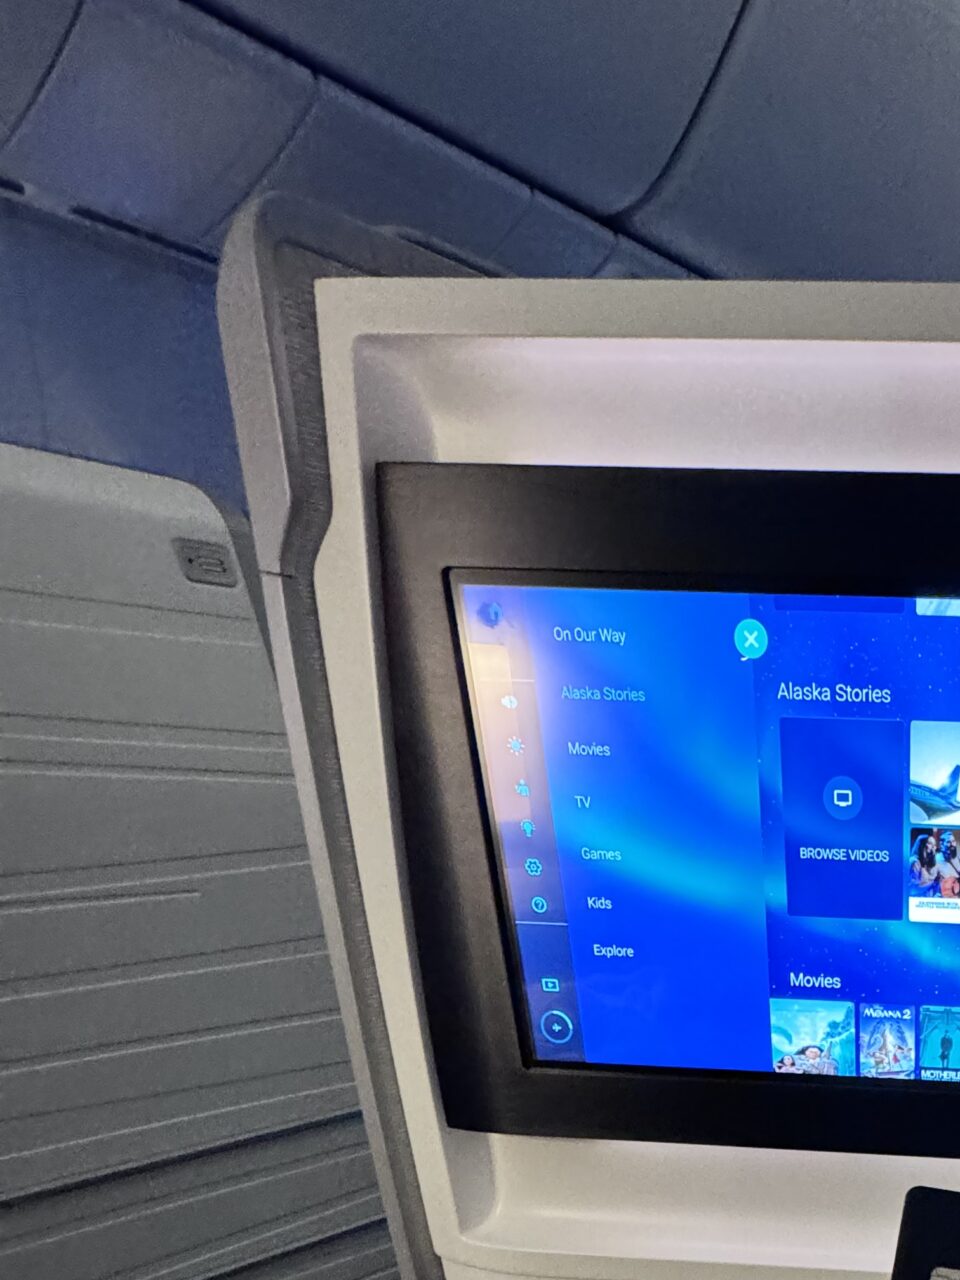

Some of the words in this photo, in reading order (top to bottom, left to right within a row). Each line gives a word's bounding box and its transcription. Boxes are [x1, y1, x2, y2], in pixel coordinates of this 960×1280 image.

[553, 626, 572, 642] On
[574, 627, 597, 643] Our
[599, 628, 626, 646] Way
[561, 685, 601, 701] Alaska
[602, 686, 646, 702] Stories
[777, 682, 831, 702] Alaska
[835, 683, 891, 704] Stories
[567, 741, 611, 757] Movies
[574, 795, 591, 809] TV
[581, 847, 622, 862] Games
[799, 846, 847, 862] BROWSE
[849, 848, 890, 863] VIDEOS
[587, 896, 613, 910] Kids
[593, 943, 635, 958] Explore
[789, 971, 842, 989] Movies
[863, 1007, 902, 1019] MOANA
[902, 1008, 912, 1020] 2
